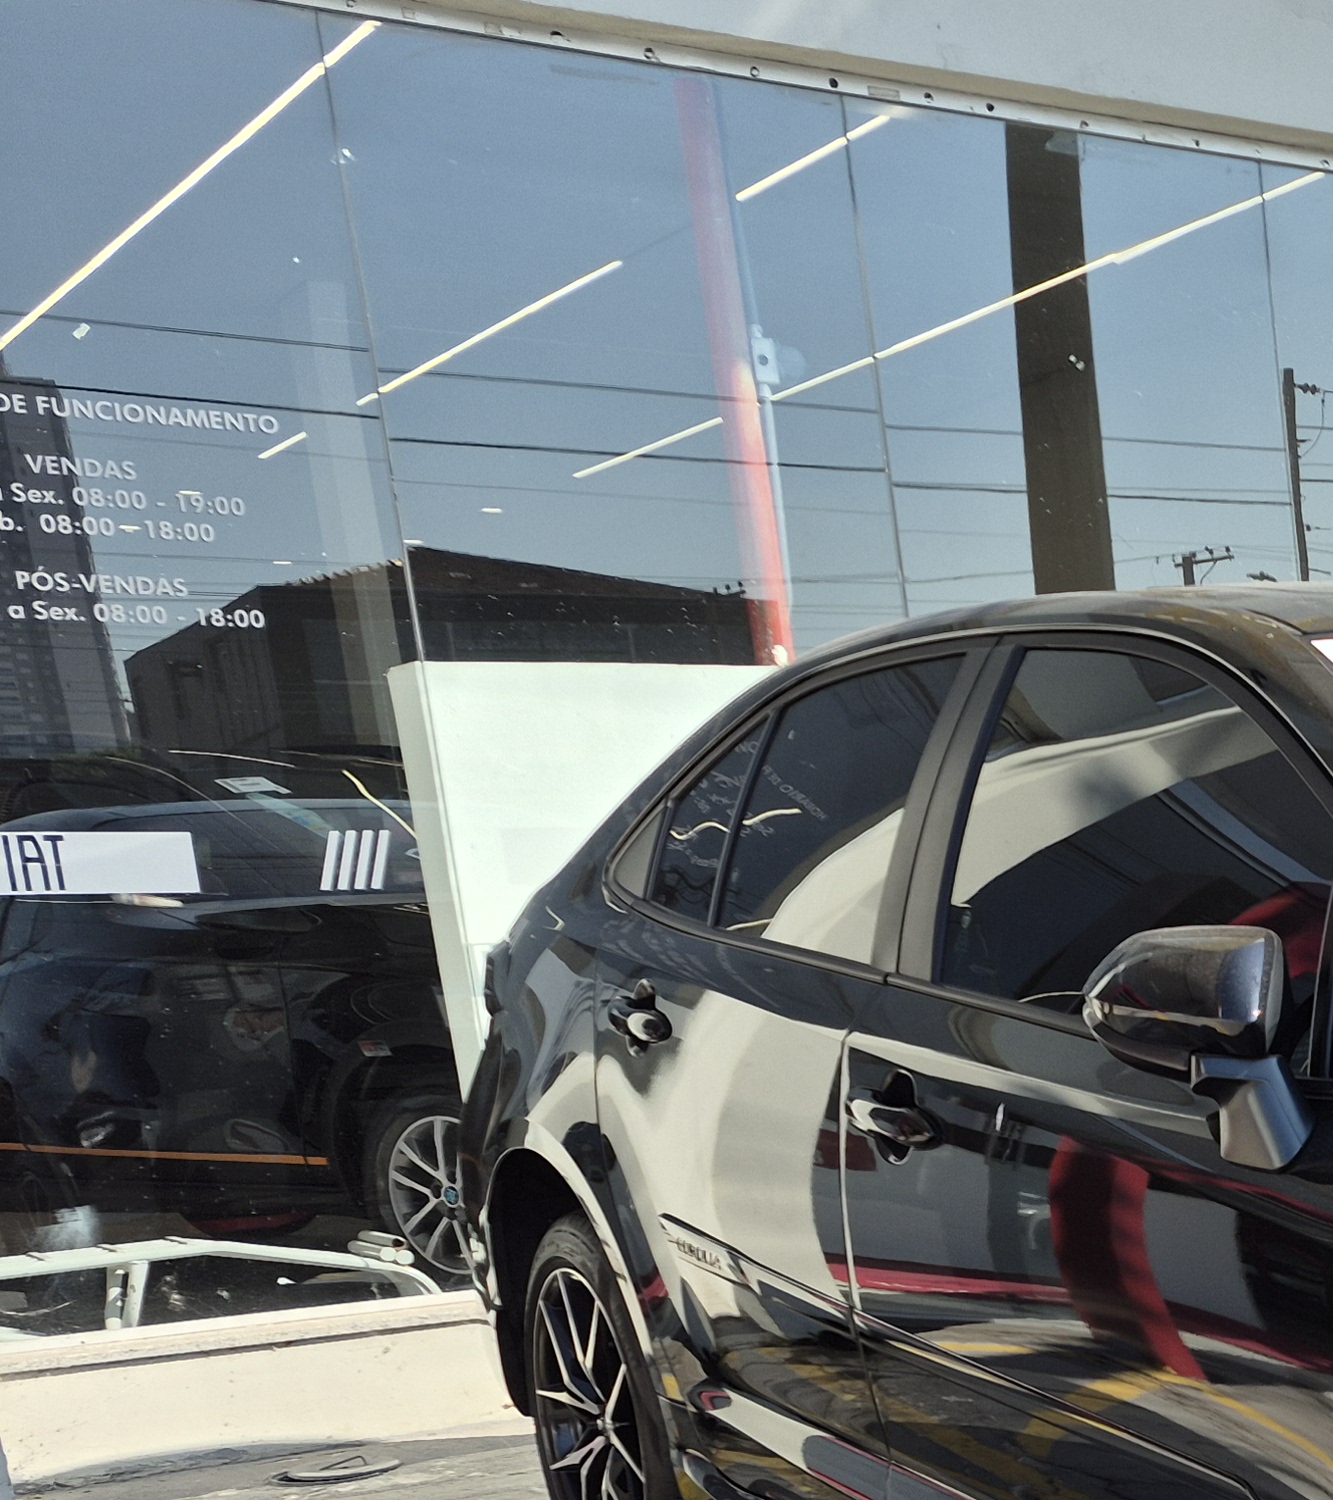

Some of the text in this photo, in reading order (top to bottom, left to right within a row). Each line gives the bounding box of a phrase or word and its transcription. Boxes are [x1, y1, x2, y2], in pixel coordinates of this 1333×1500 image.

[35, 396, 280, 434] FUNCIONAMENTO
[24, 453, 138, 480] VENDAS
[10, 482, 64, 506] Sex.
[72, 486, 147, 511] 08:00
[176, 493, 246, 517] 19:00
[40, 514, 115, 537] 08:00
[144, 520, 215, 542] 18:00
[15, 566, 189, 597] PÓS-VENDAS
[8, 604, 26, 620] a
[32, 601, 85, 622] Sex.
[93, 604, 168, 624] 08:00
[197, 608, 265, 629] 18:00
